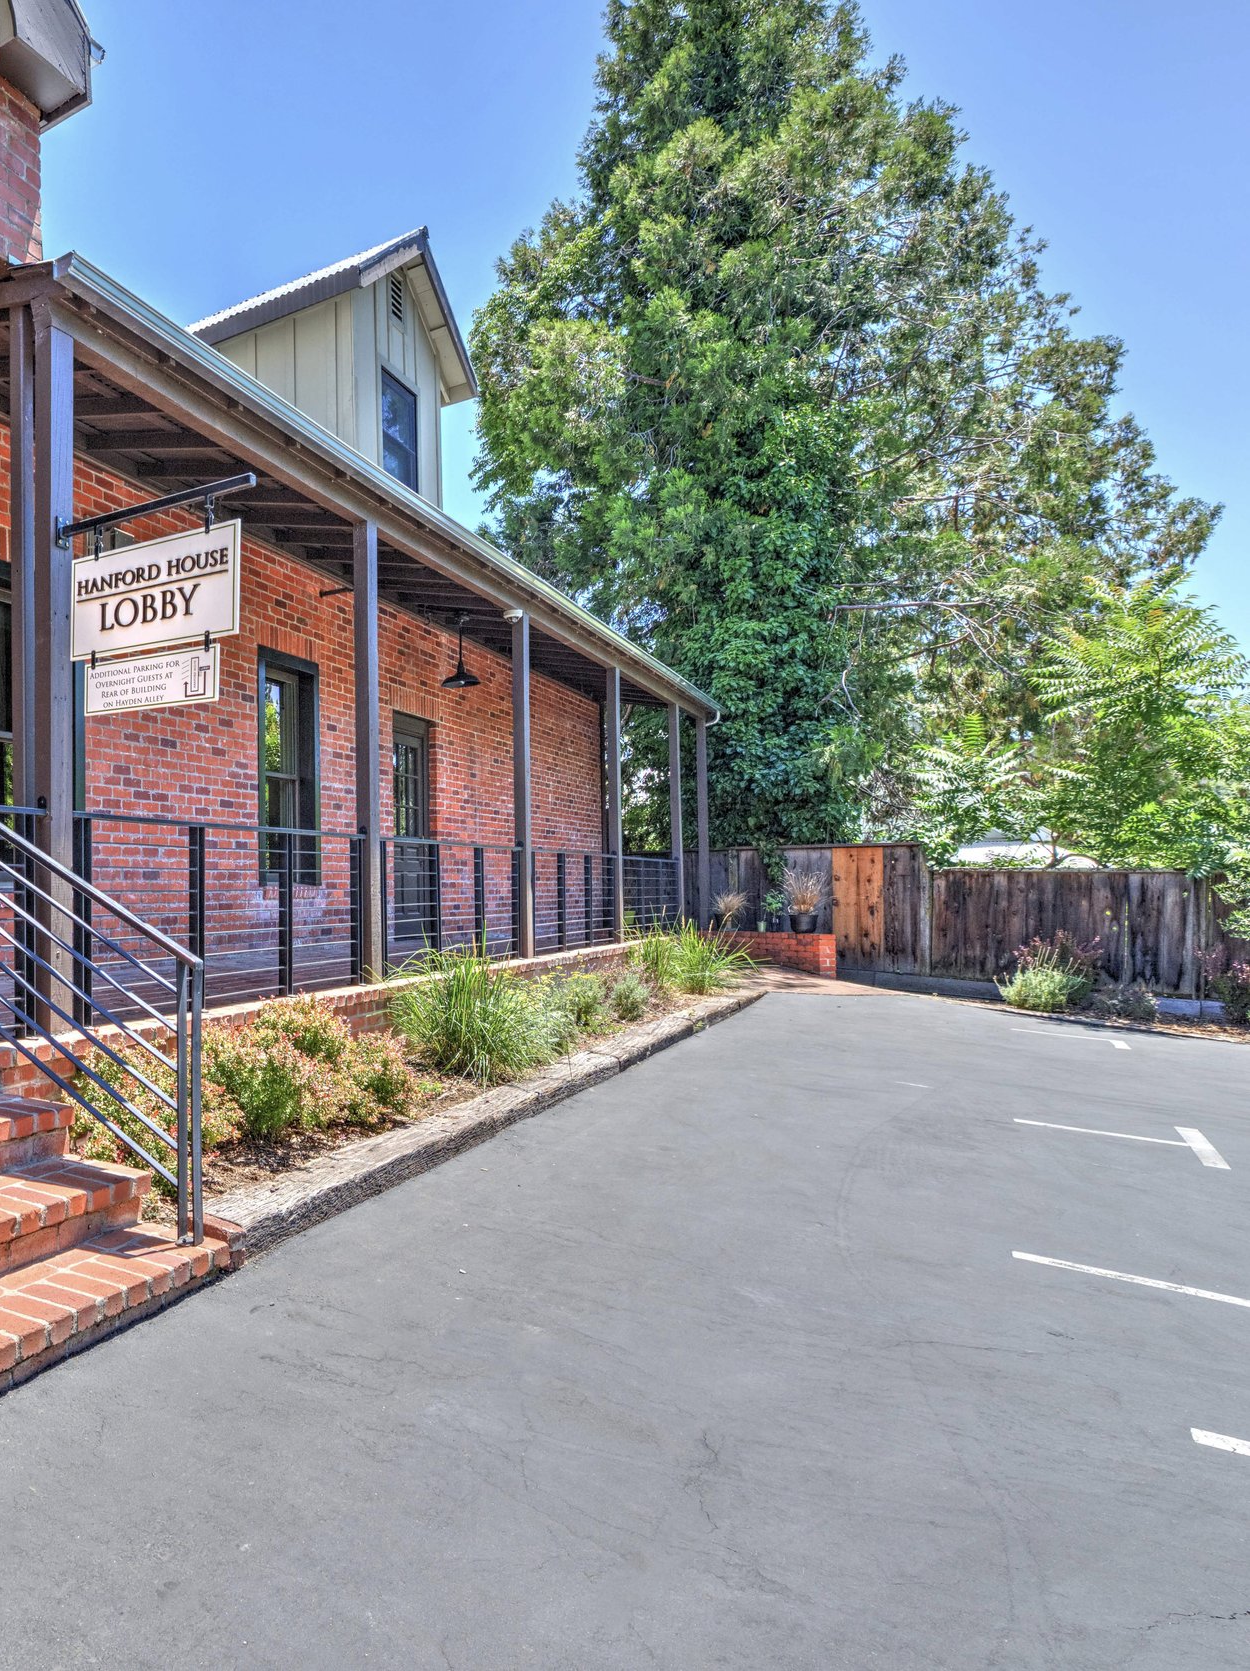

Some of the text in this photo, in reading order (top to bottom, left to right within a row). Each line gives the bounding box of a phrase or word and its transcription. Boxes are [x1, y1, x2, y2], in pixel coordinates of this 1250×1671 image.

[77, 547, 229, 597] HANFORD HOUSE
[99, 583, 201, 632] LOBBY
[90, 660, 180, 680] ADDITIONAL PARKING FOR
[95, 675, 136, 689] OVERNIGHT
[137, 672, 163, 683] GUESTS
[101, 683, 167, 699] REAR OF BUILDING
[103, 694, 165, 709] ON HAYDEN ALLEY
